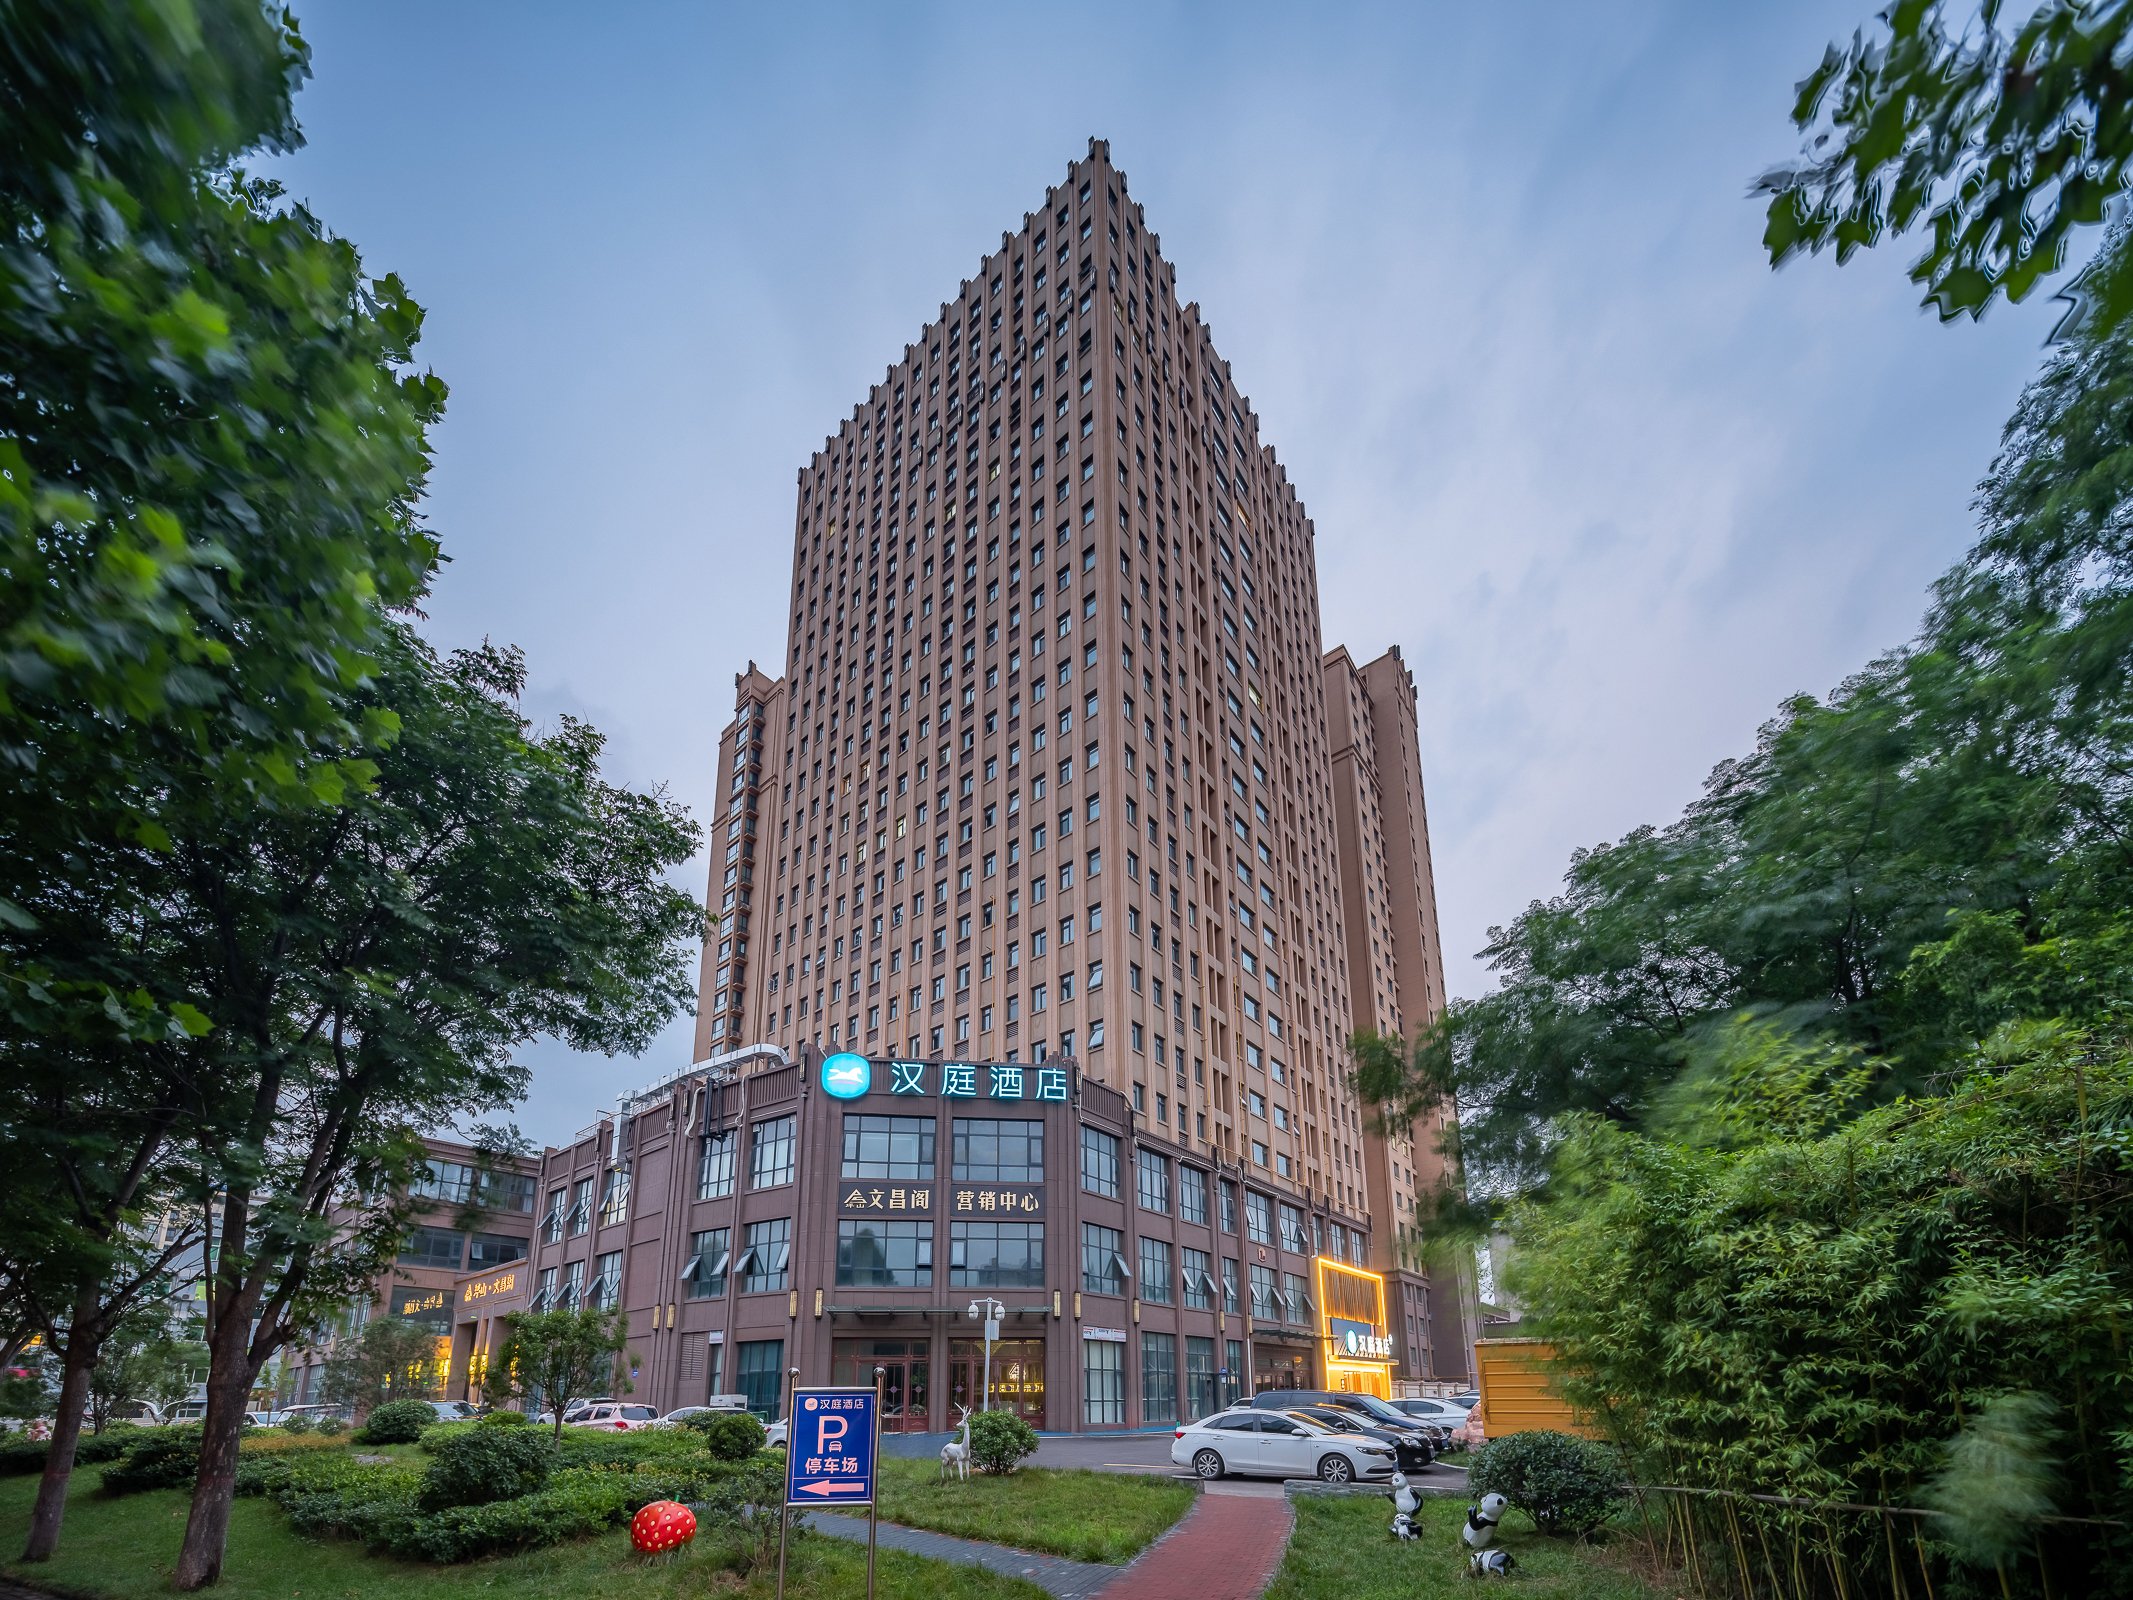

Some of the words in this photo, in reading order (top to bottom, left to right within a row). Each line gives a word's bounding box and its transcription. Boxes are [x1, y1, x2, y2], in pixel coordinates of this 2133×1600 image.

[890, 1062, 1067, 1101] 汉庭酒店
[867, 1188, 930, 1210] 文昌阁
[956, 1190, 1040, 1212] 营销中心
[819, 1398, 864, 1410] 汉庭酒店
[817, 1415, 849, 1455] P
[804, 1457, 858, 1475] 停车场
